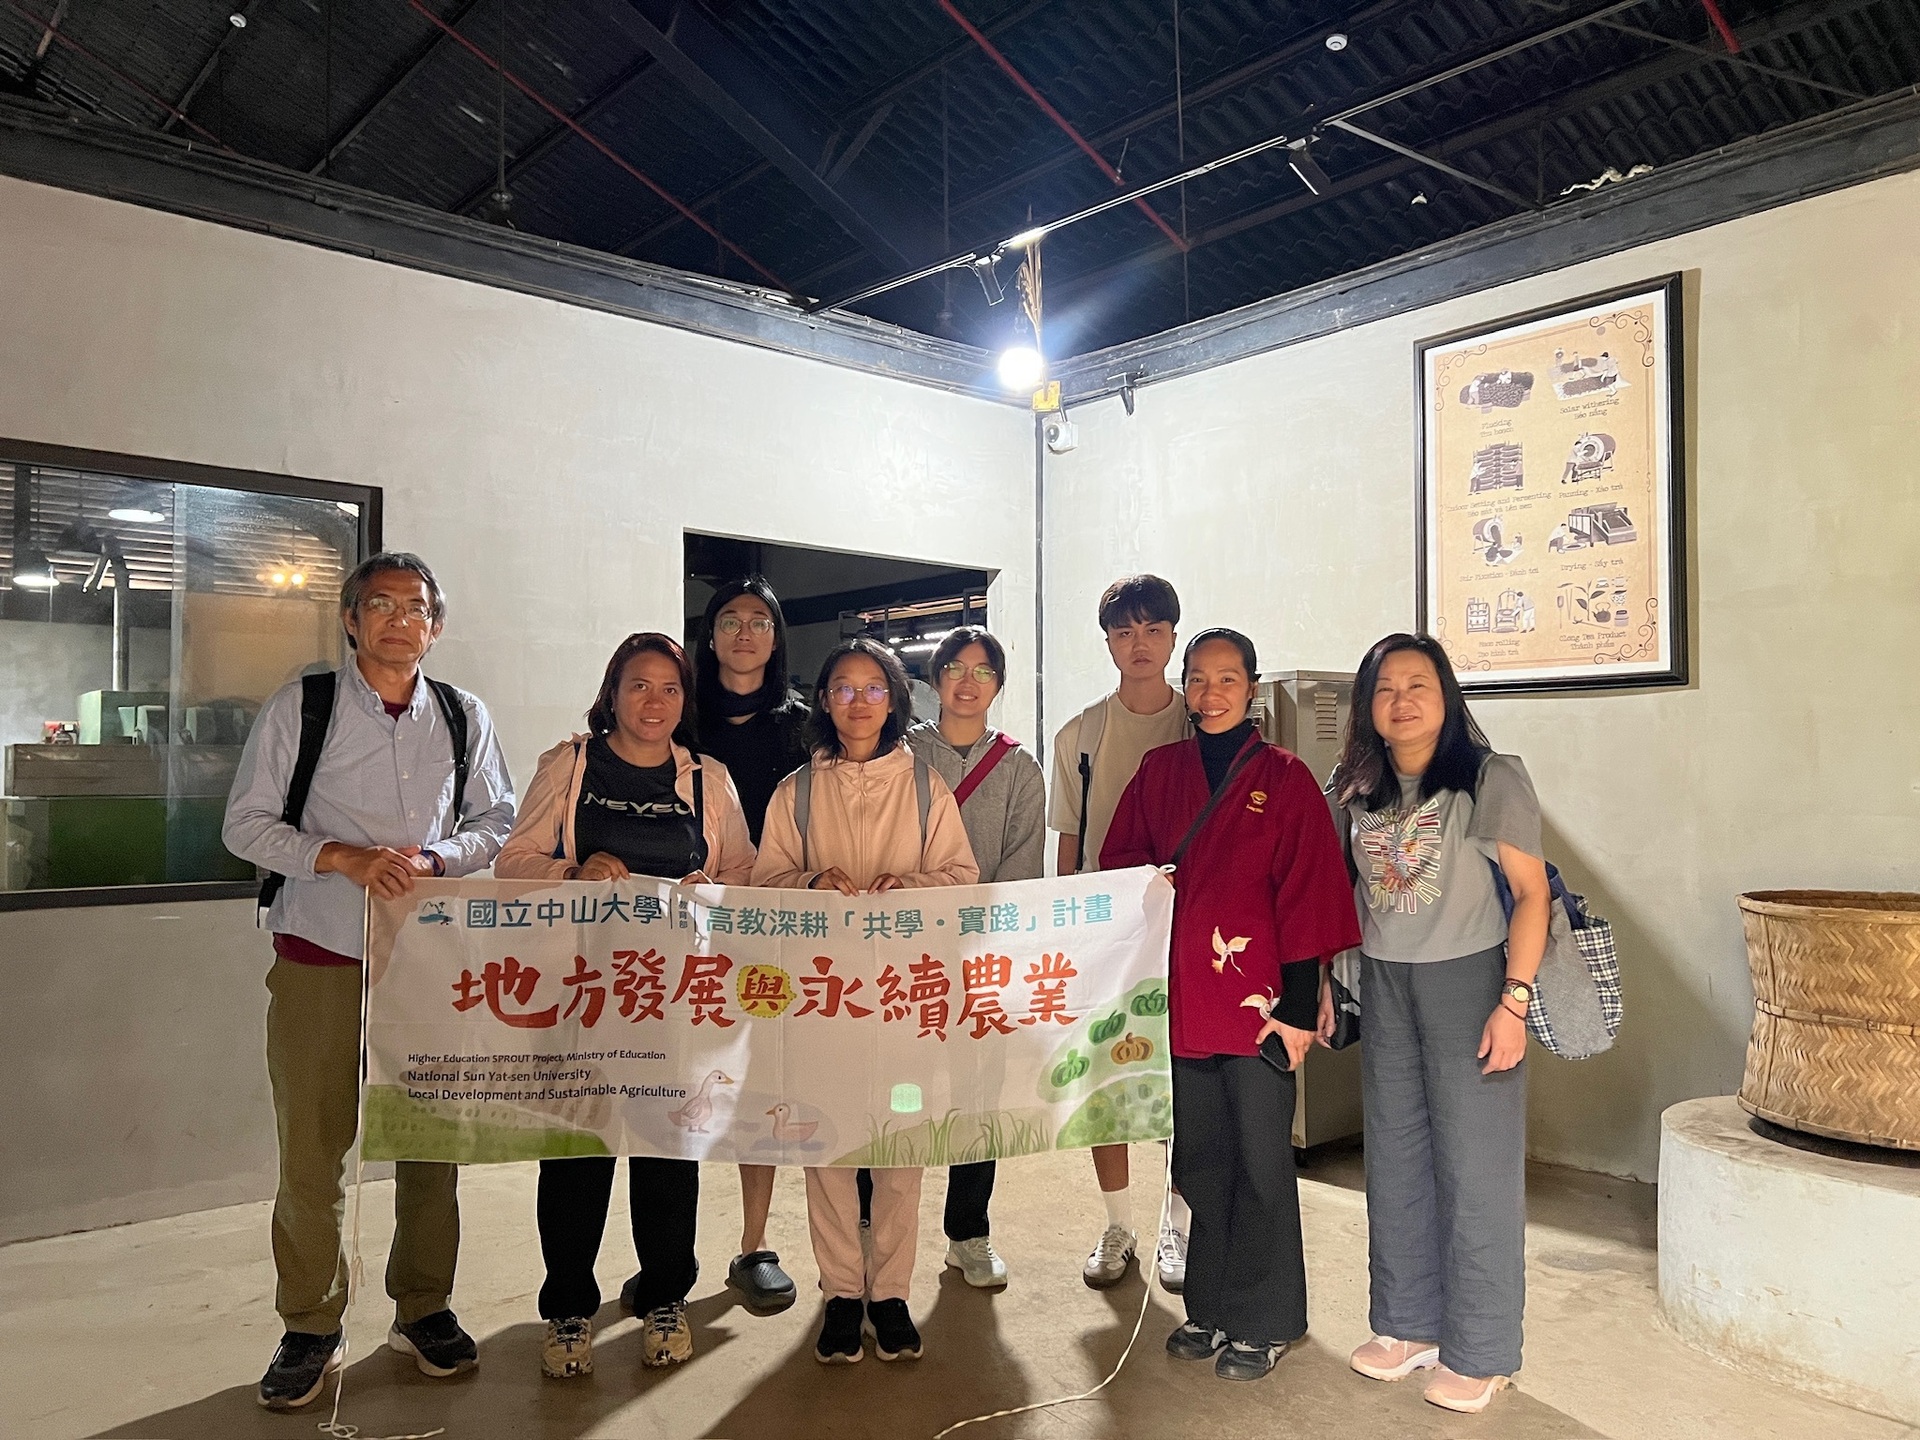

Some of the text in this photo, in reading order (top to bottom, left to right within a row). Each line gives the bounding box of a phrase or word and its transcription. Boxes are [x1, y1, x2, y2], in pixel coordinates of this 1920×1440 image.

[467, 893, 662, 928] 國立中山大學
[451, 948, 1079, 1042] 地方發展與永續農業
[408, 1049, 666, 1065] Higher Education SPROUT Project, Ministry of Education
[407, 1068, 592, 1082] National Sun Yat-sen University
[408, 1083, 686, 1102] Local Development and Sustainable Agriculture
